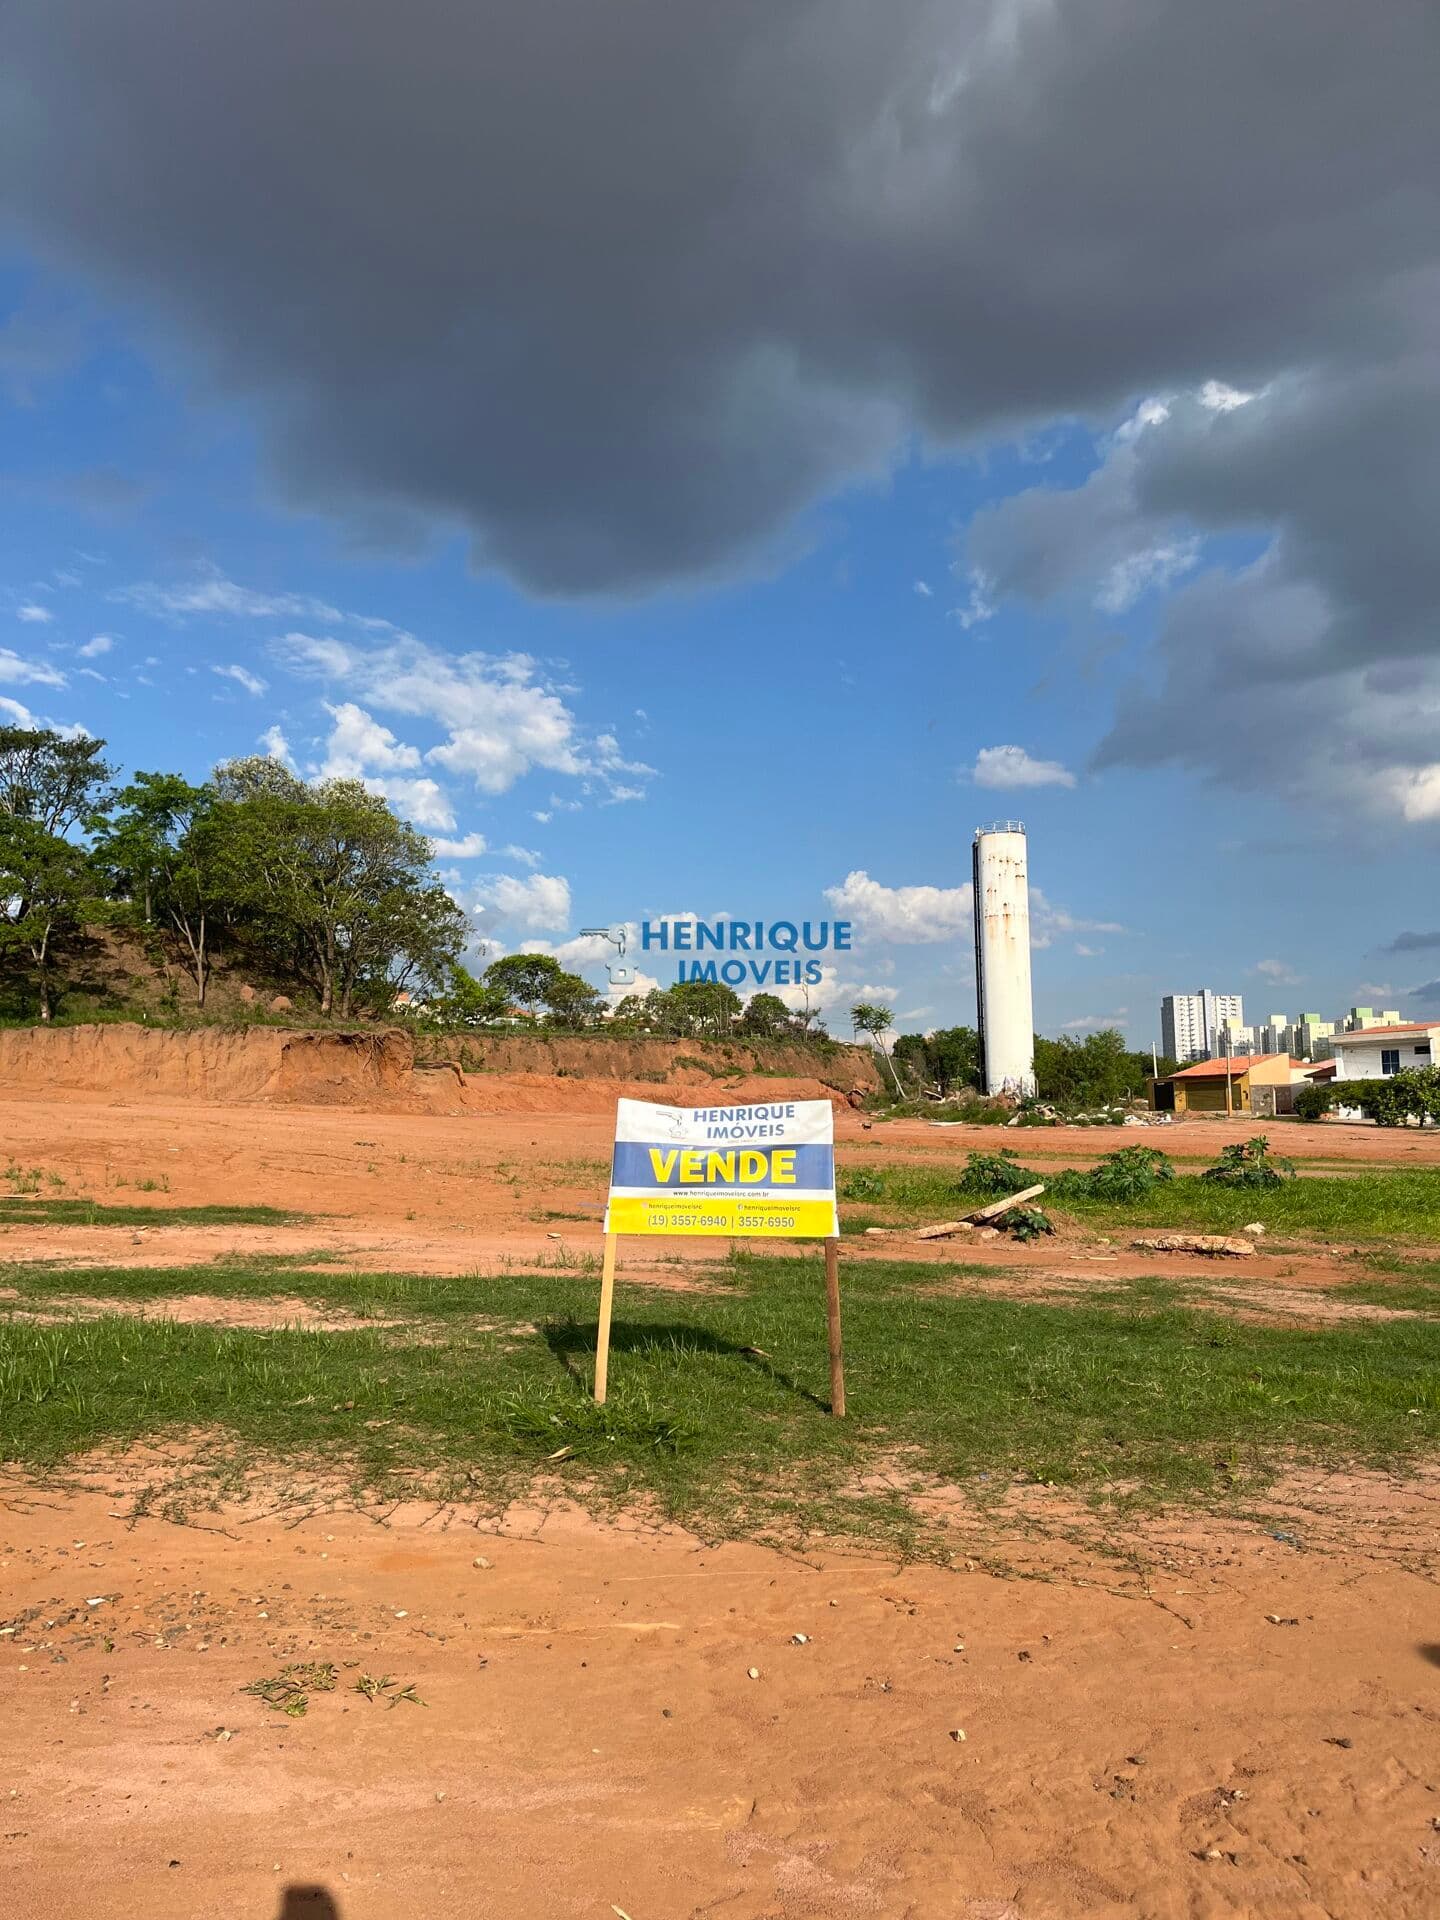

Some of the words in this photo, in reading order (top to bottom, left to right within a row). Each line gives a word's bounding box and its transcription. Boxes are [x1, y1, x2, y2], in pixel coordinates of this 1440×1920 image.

[693, 1104, 795, 1122] HENRIQUE
[706, 1122, 785, 1139] IMÓVEIS
[648, 1148, 797, 1184] VENDE
[648, 1214, 669, 1228] (19)
[671, 1215, 727, 1227] 3557-6940
[738, 1216, 795, 1228] 3557-6950
